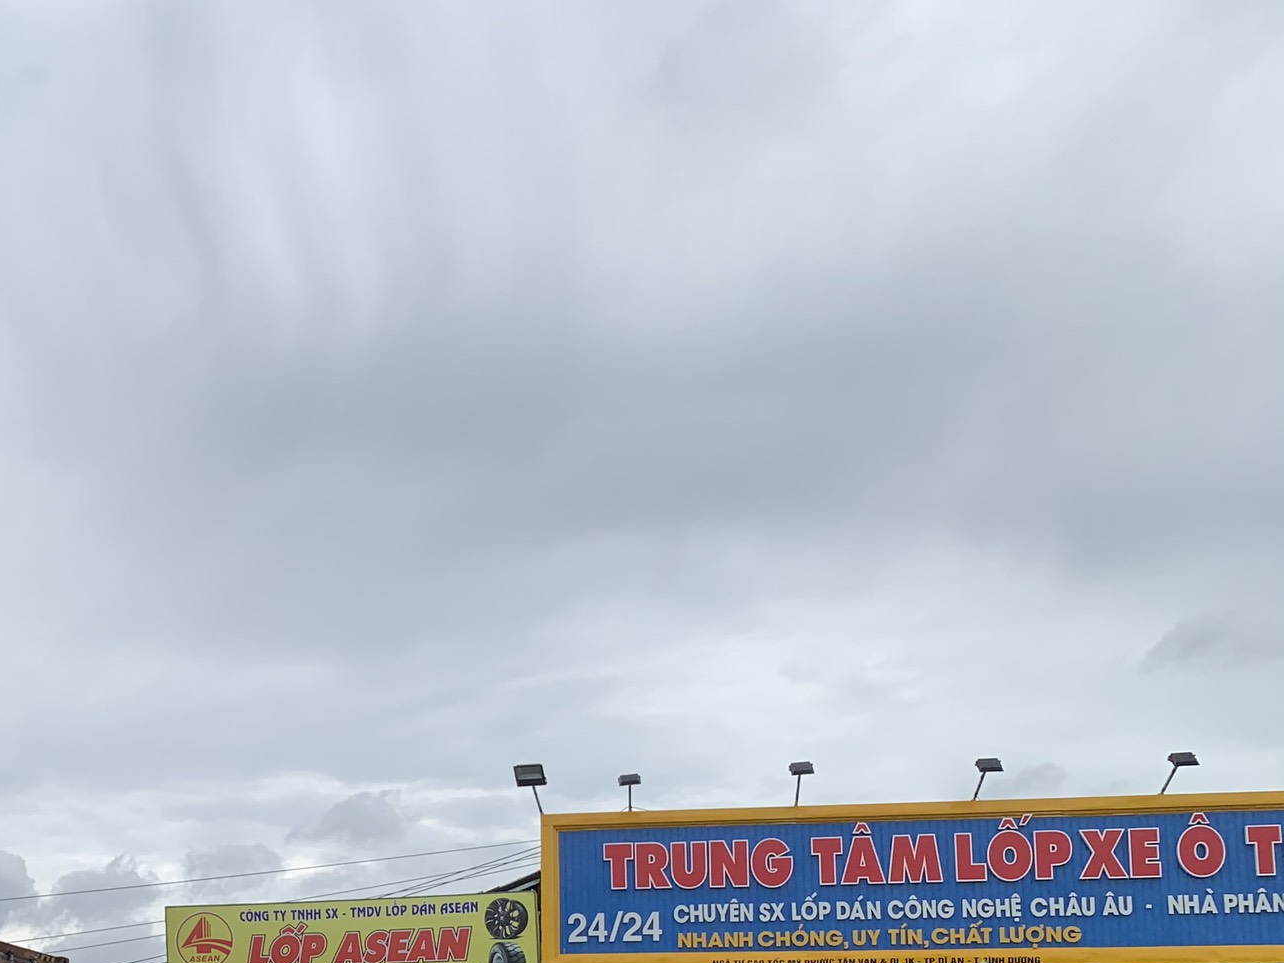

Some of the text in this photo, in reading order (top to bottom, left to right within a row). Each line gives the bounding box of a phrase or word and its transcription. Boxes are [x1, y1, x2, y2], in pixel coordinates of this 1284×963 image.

[603, 837, 794, 890] TRUNG
[811, 822, 944, 885] TÂM
[954, 813, 1073, 883] LỐP
[1079, 827, 1163, 880] XE
[1176, 812, 1226, 878] Ô
[240, 909, 269, 922] CÔNG
[273, 910, 287, 921] TY
[290, 908, 321, 921] TNHH
[325, 908, 339, 919] SX
[350, 906, 381, 918] TMDV
[386, 900, 407, 917] LỐP
[411, 901, 436, 916] DÁN
[440, 901, 478, 915] ASEAN
[673, 898, 754, 924] CHUYÊN
[759, 902, 785, 923] SX
[791, 892, 831, 921] LỐP
[836, 896, 882, 921] DÁN
[887, 894, 955, 920] CÔNG
[962, 893, 1021, 922] NGHỆ
[1030, 892, 1095, 918] CHÂU
[1102, 891, 1133, 916] ÂU
[1168, 888, 1218, 915] NHÀ
[1224, 887, 1284, 914] PHÂN
[567, 911, 662, 944] 24/24
[677, 921, 1082, 950] NHANH CHÓNG, UY TÍN, CHẤT LƯỢNG
[189, 955, 221, 963] ASEAN
